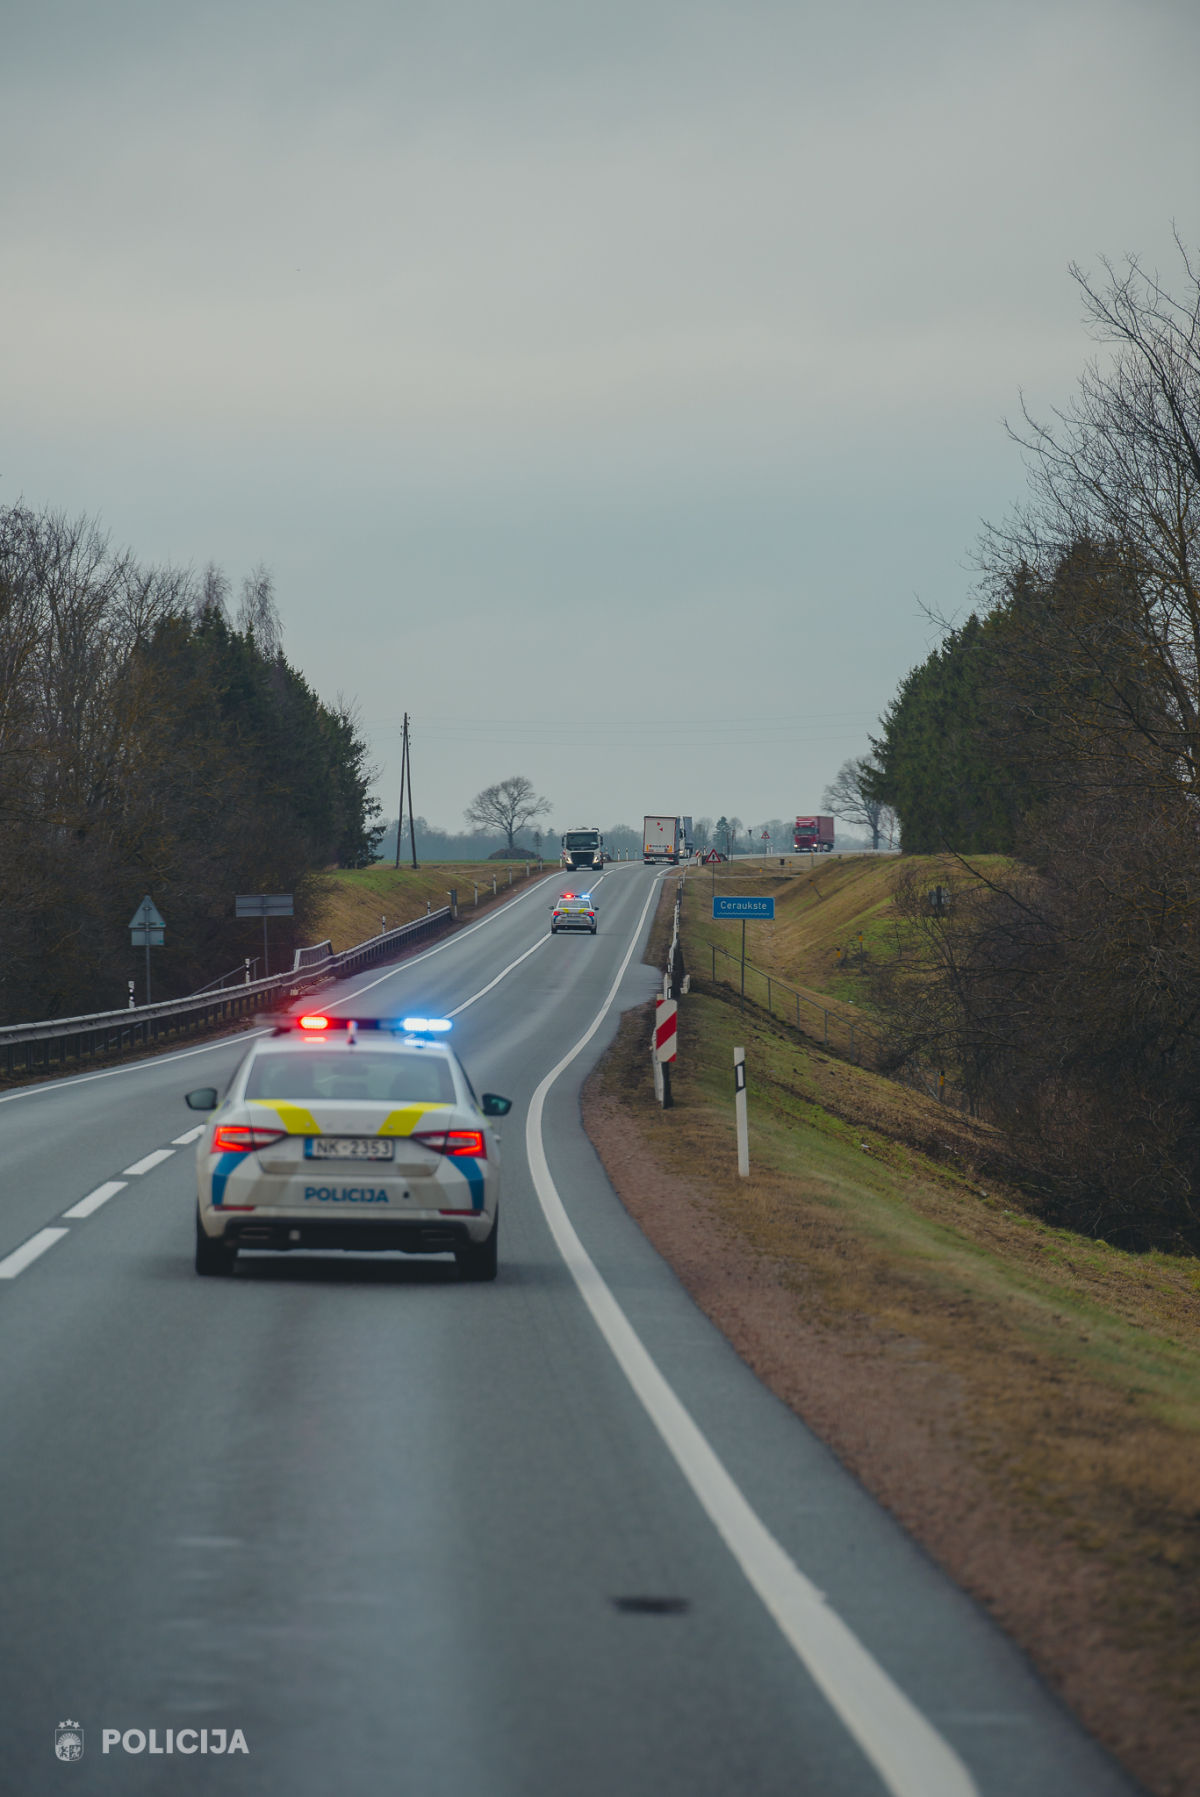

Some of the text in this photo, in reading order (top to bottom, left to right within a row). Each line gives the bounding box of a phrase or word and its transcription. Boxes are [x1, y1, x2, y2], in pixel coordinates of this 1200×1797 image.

[720, 900, 767, 910] Ceraukste
[316, 1139, 390, 1155] NK-2353
[304, 1187, 389, 1203] POLICIJA
